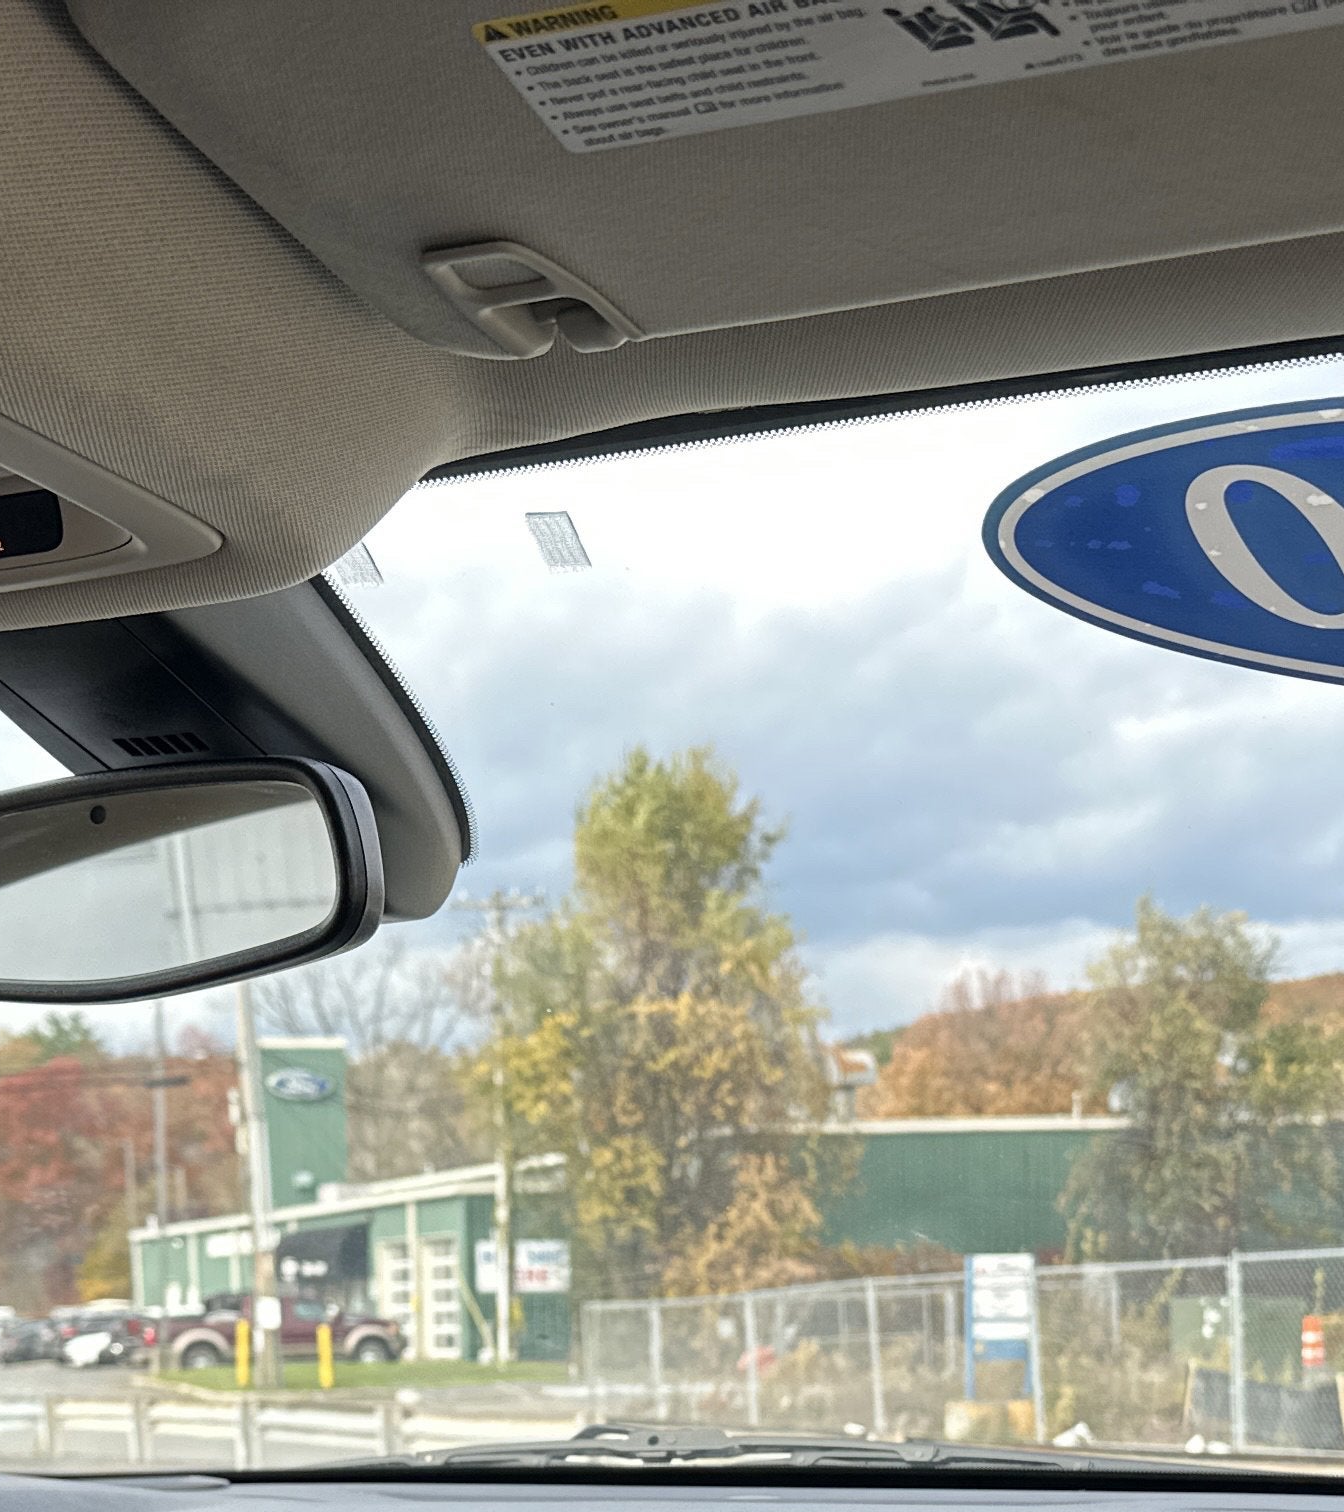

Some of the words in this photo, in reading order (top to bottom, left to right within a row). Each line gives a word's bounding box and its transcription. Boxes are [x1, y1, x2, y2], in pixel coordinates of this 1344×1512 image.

[499, 42, 556, 63] EVEN
[558, 31, 618, 52] WITH
[622, 8, 740, 41] ADVANCED
[747, 0, 789, 18] AIR
[508, 5, 618, 37] WARNING
[526, 60, 575, 76] Children
